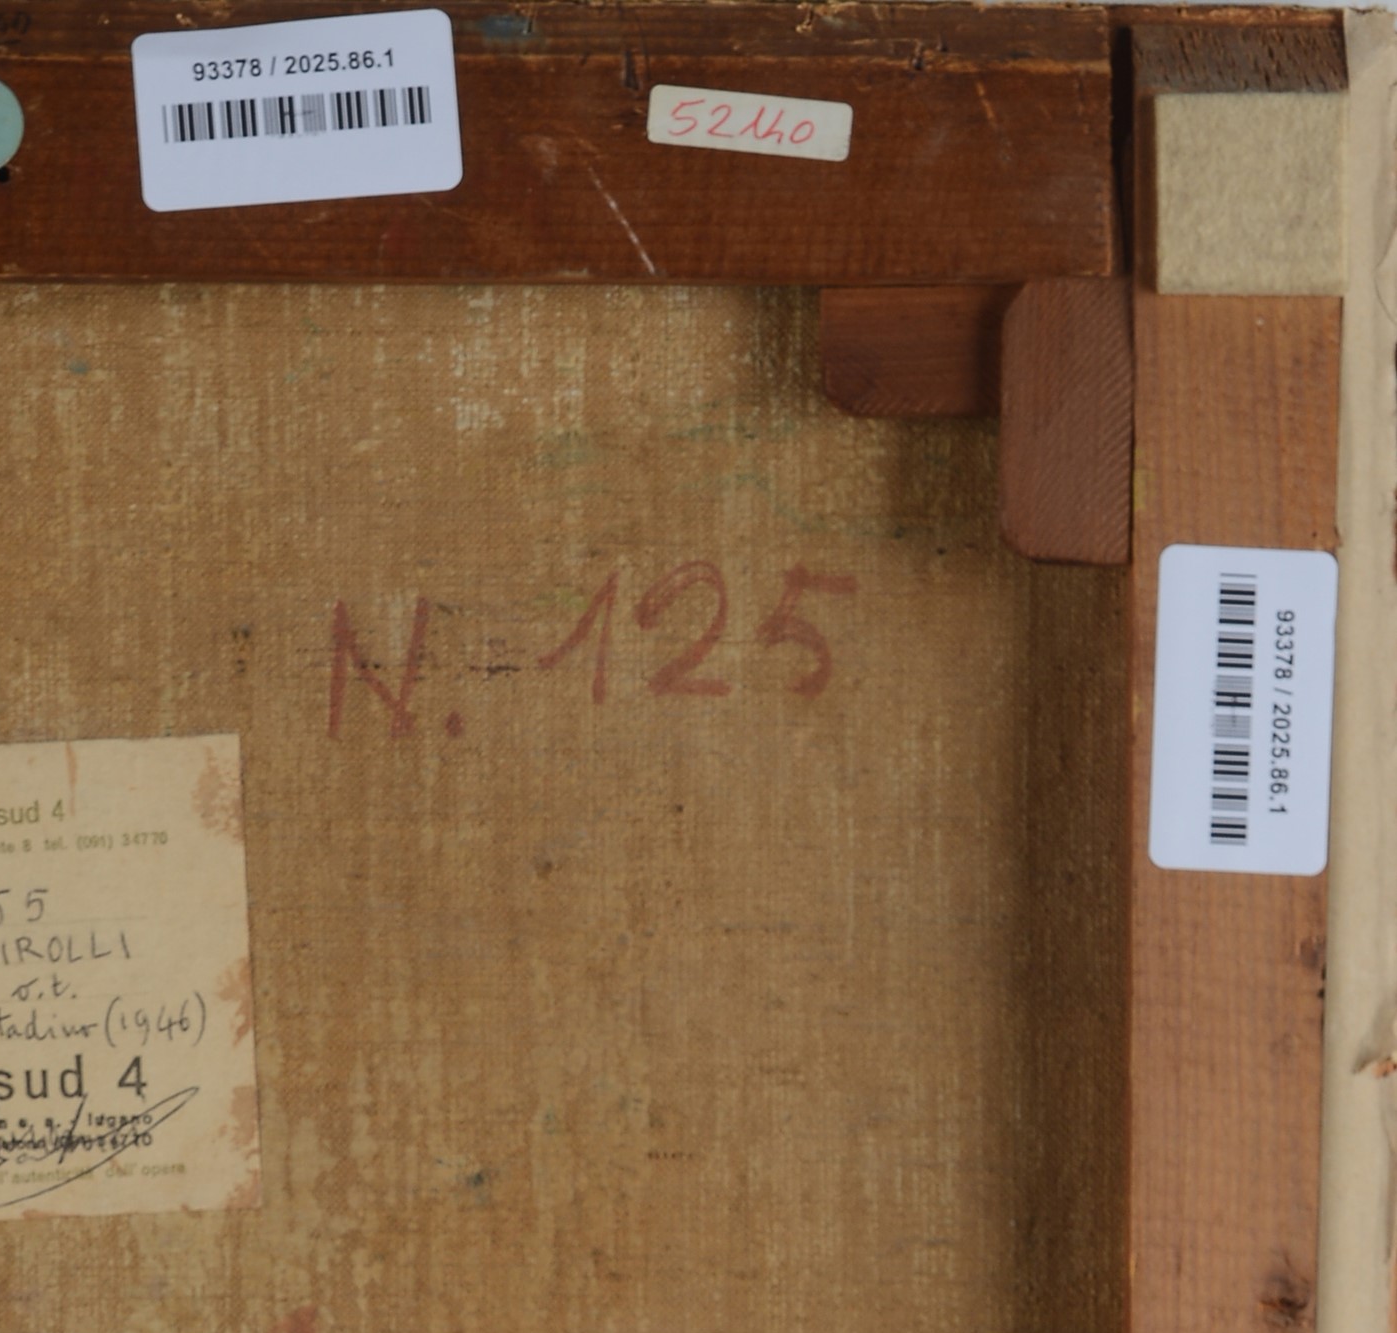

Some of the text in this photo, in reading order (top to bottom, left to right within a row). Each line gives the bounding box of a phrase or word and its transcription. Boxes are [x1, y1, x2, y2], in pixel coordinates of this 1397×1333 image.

[192, 48, 395, 82] 93378 / 2025.86.1
[536, 558, 859, 706] 125
[1268, 609, 1295, 815] 93378 / 2025.86.1
[52, 799, 65, 822] 4
[44, 837, 68, 851] tel.
[117, 1055, 148, 1097] 4
